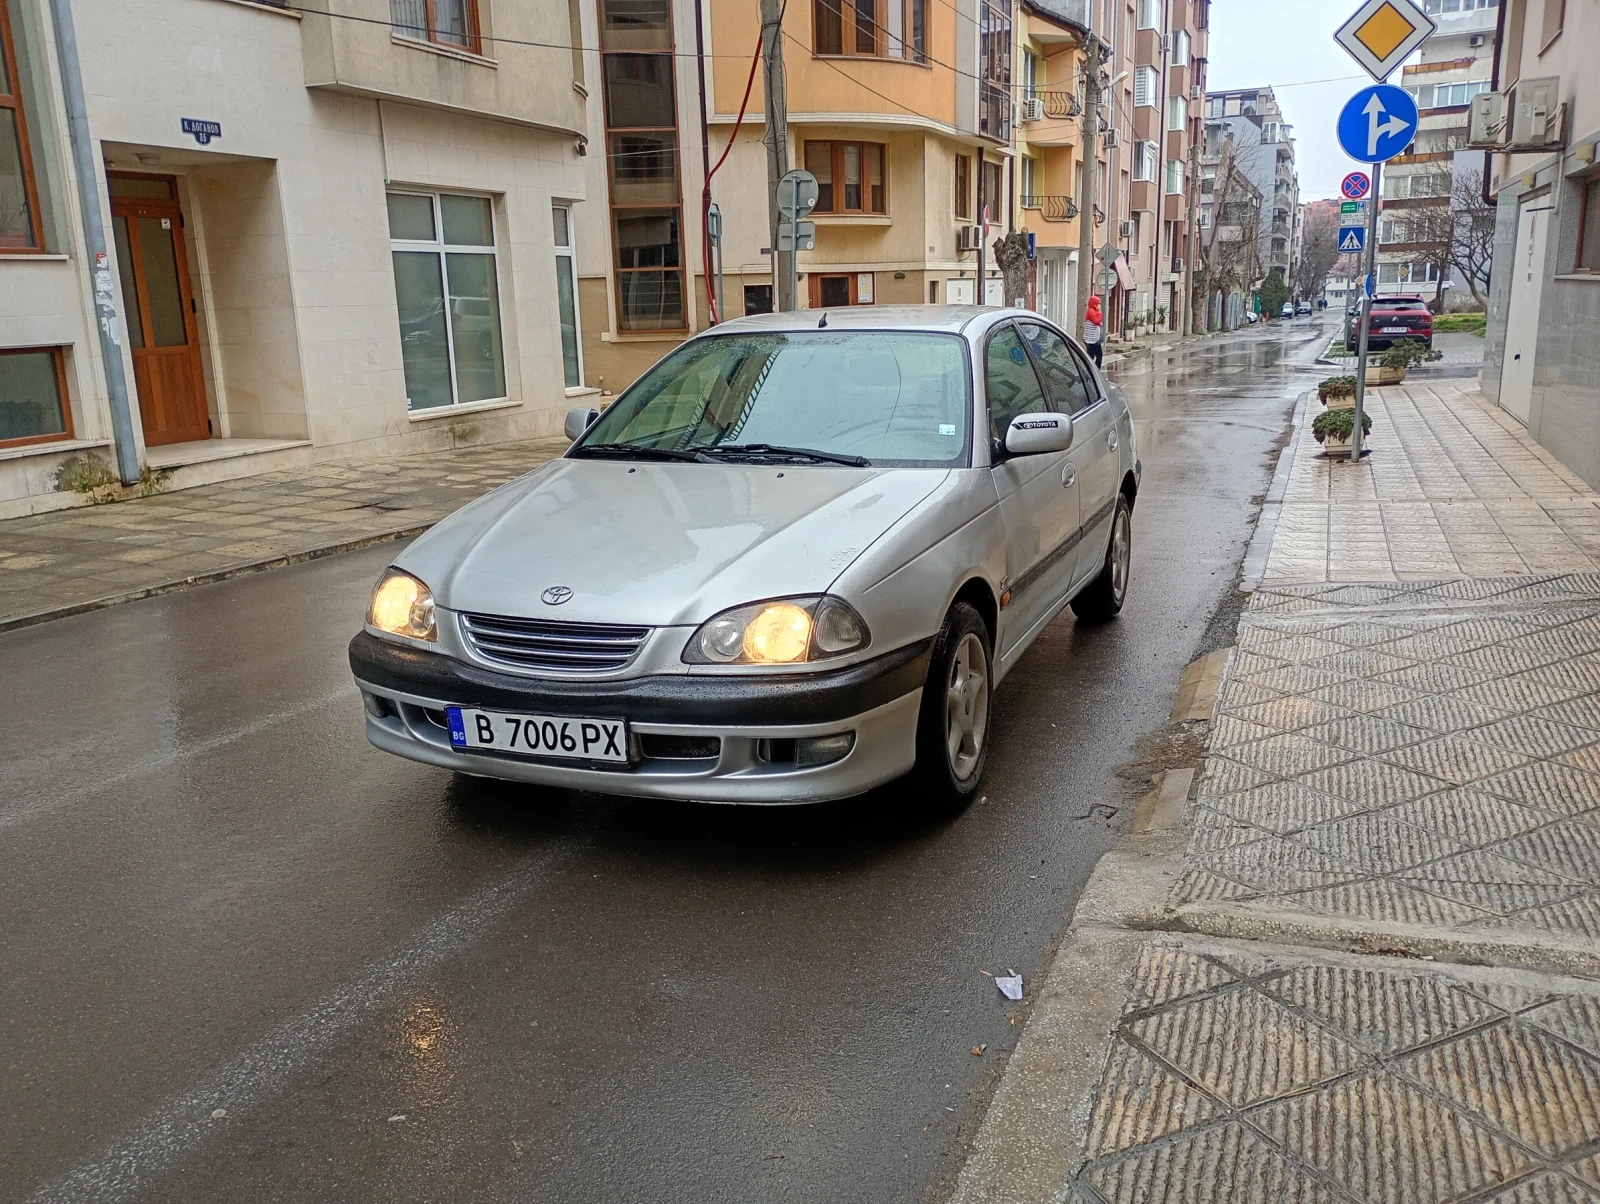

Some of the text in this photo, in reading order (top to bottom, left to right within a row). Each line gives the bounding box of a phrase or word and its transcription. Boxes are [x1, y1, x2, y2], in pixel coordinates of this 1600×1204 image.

[192, 121, 219, 133] ДОГАНОВ
[475, 714, 495, 744] B
[452, 731, 465, 741] BG
